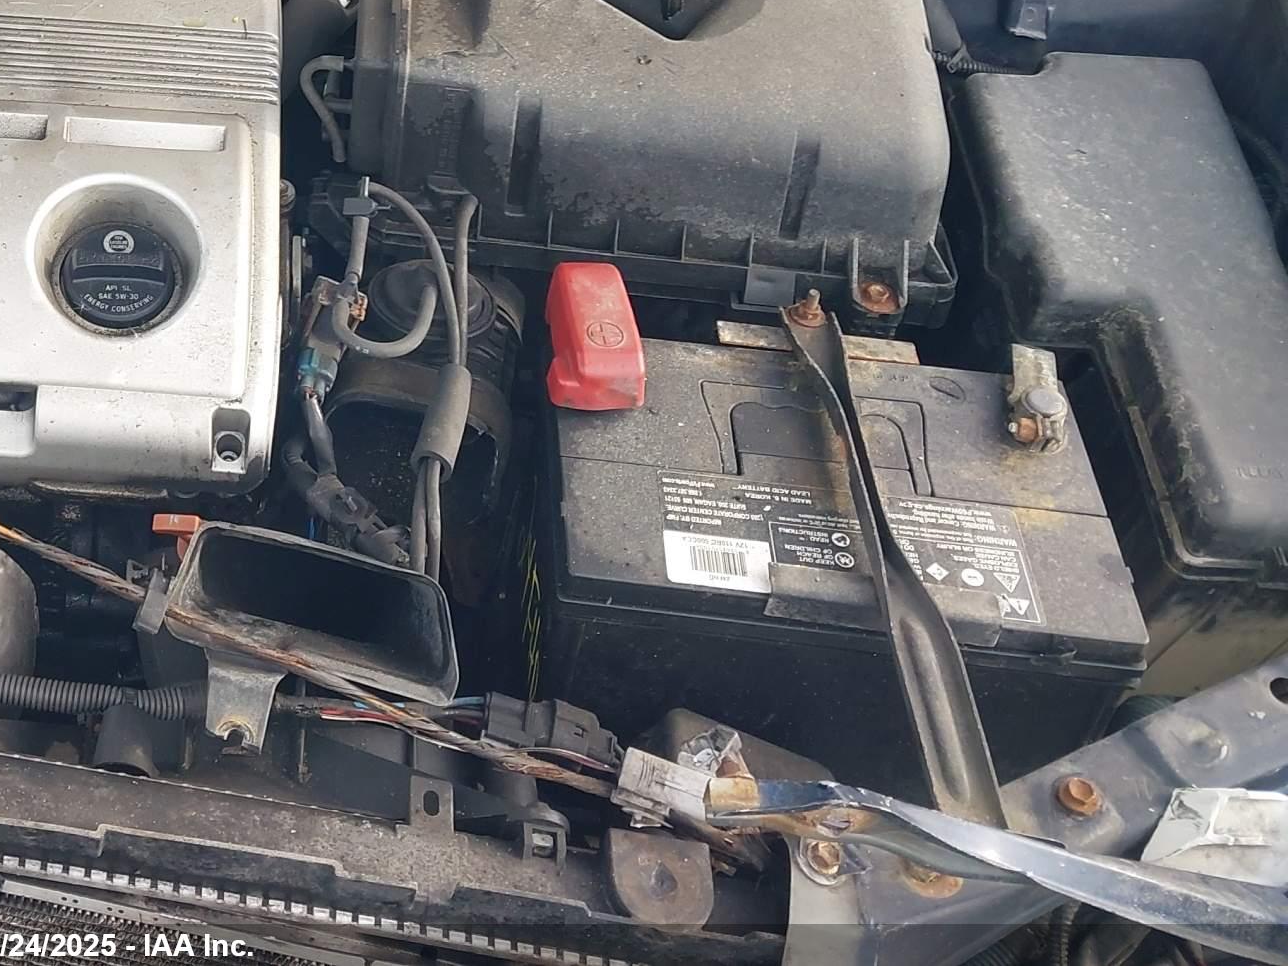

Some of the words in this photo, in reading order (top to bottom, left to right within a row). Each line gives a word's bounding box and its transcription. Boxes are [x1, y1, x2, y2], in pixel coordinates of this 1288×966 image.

[105, 284, 118, 292] API
[98, 293, 113, 301] SAE
[83, 293, 110, 311] ENERGY
[111, 294, 154, 313] CONSERVING
[713, 510, 749, 519] CORPORATE
[961, 521, 996, 531] WARNING:
[974, 535, 1017, 546] WARNING:
[784, 544, 821, 553] CHILDREN
